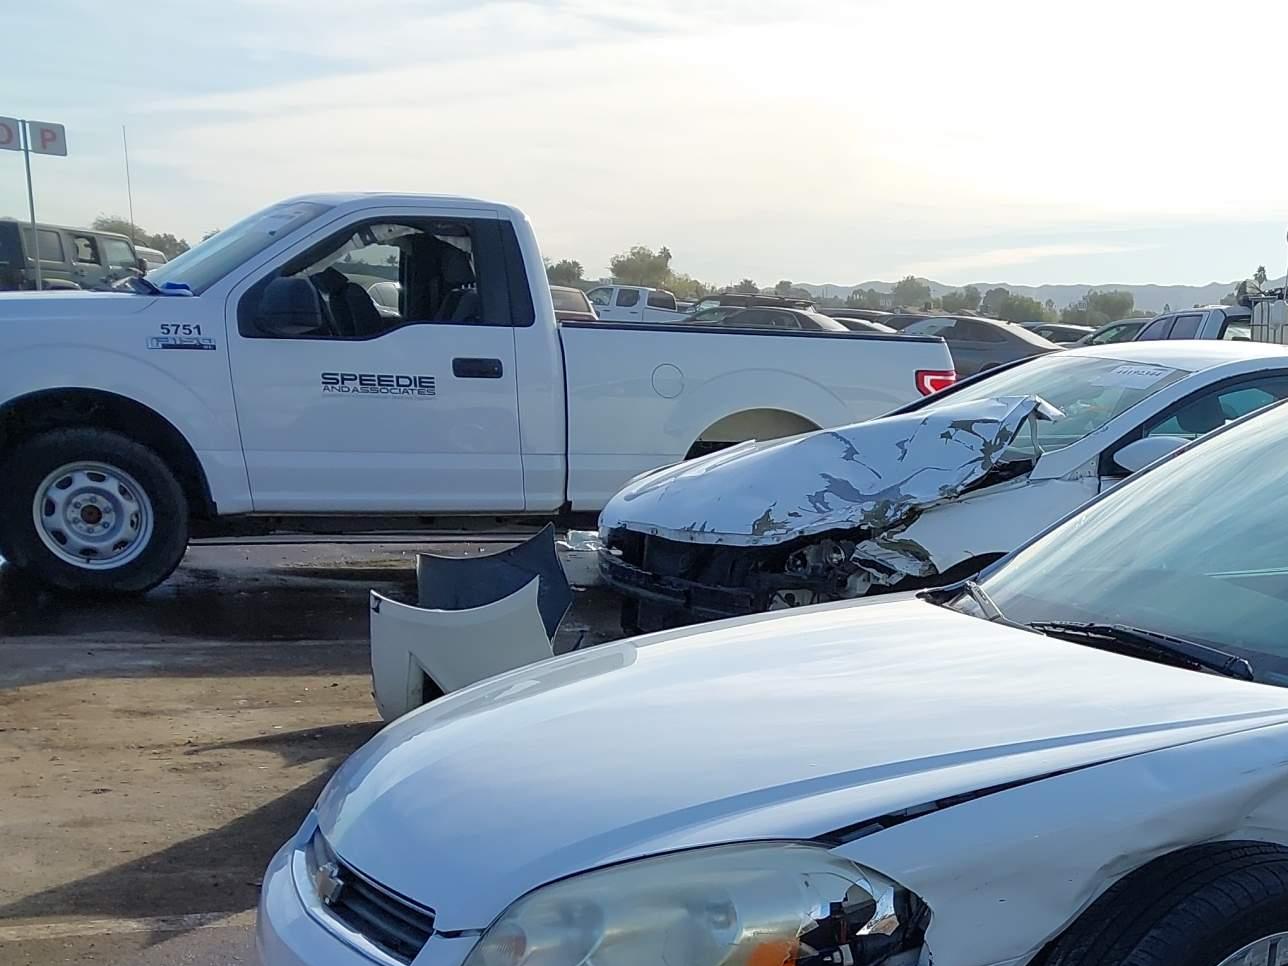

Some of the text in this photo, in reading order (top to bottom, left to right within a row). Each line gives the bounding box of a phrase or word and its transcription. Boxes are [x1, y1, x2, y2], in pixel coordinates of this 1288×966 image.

[41, 128, 57, 150] P
[160, 323, 201, 336] 5751
[321, 372, 436, 388] SPEEDIE
[322, 385, 436, 396] AND ASSOCIATES
